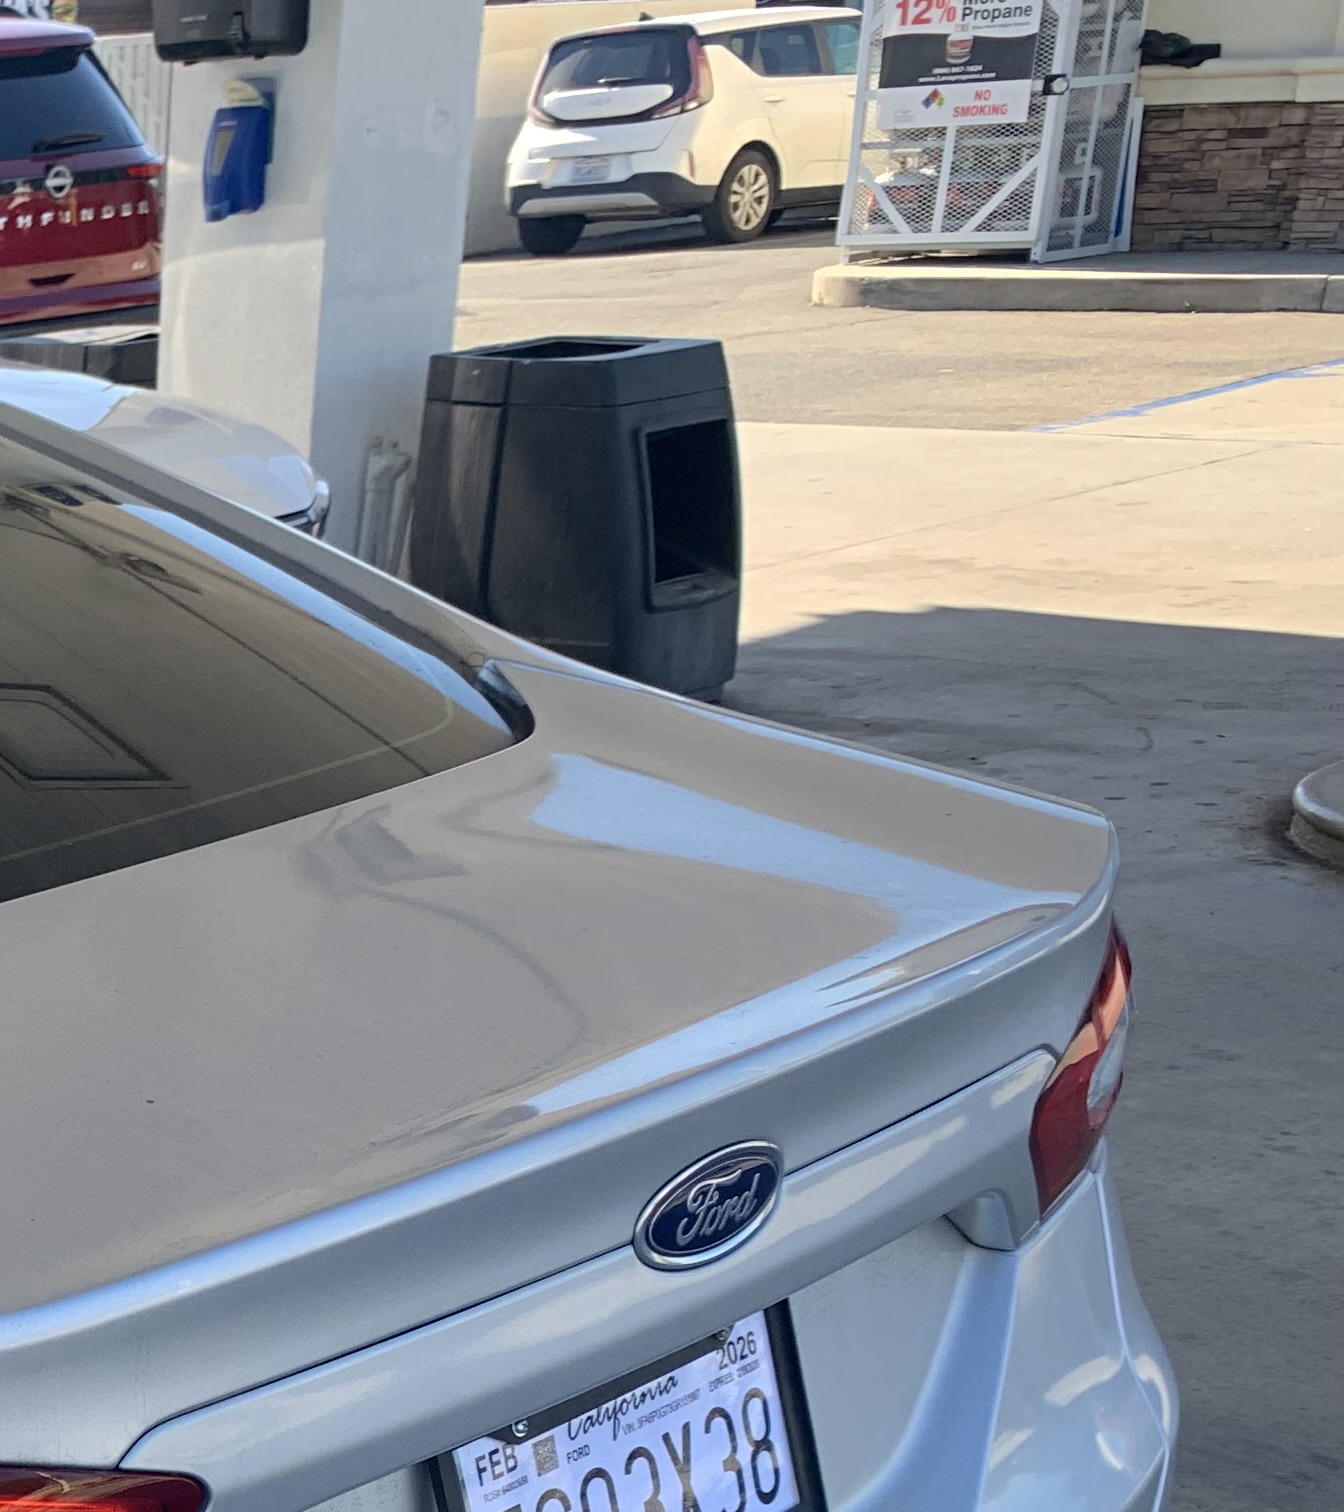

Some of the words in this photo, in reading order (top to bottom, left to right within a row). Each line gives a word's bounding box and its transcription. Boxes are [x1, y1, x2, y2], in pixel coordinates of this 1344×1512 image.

[896, 0, 957, 26] 12%
[961, 5, 1033, 23] Propane
[974, 89, 991, 101] NO
[952, 103, 1009, 118] SMOKING
[675, 1168, 761, 1247] Ford
[715, 1330, 758, 1371] 2026
[474, 1443, 519, 1488] FEB
[566, 1444, 591, 1465] FORD
